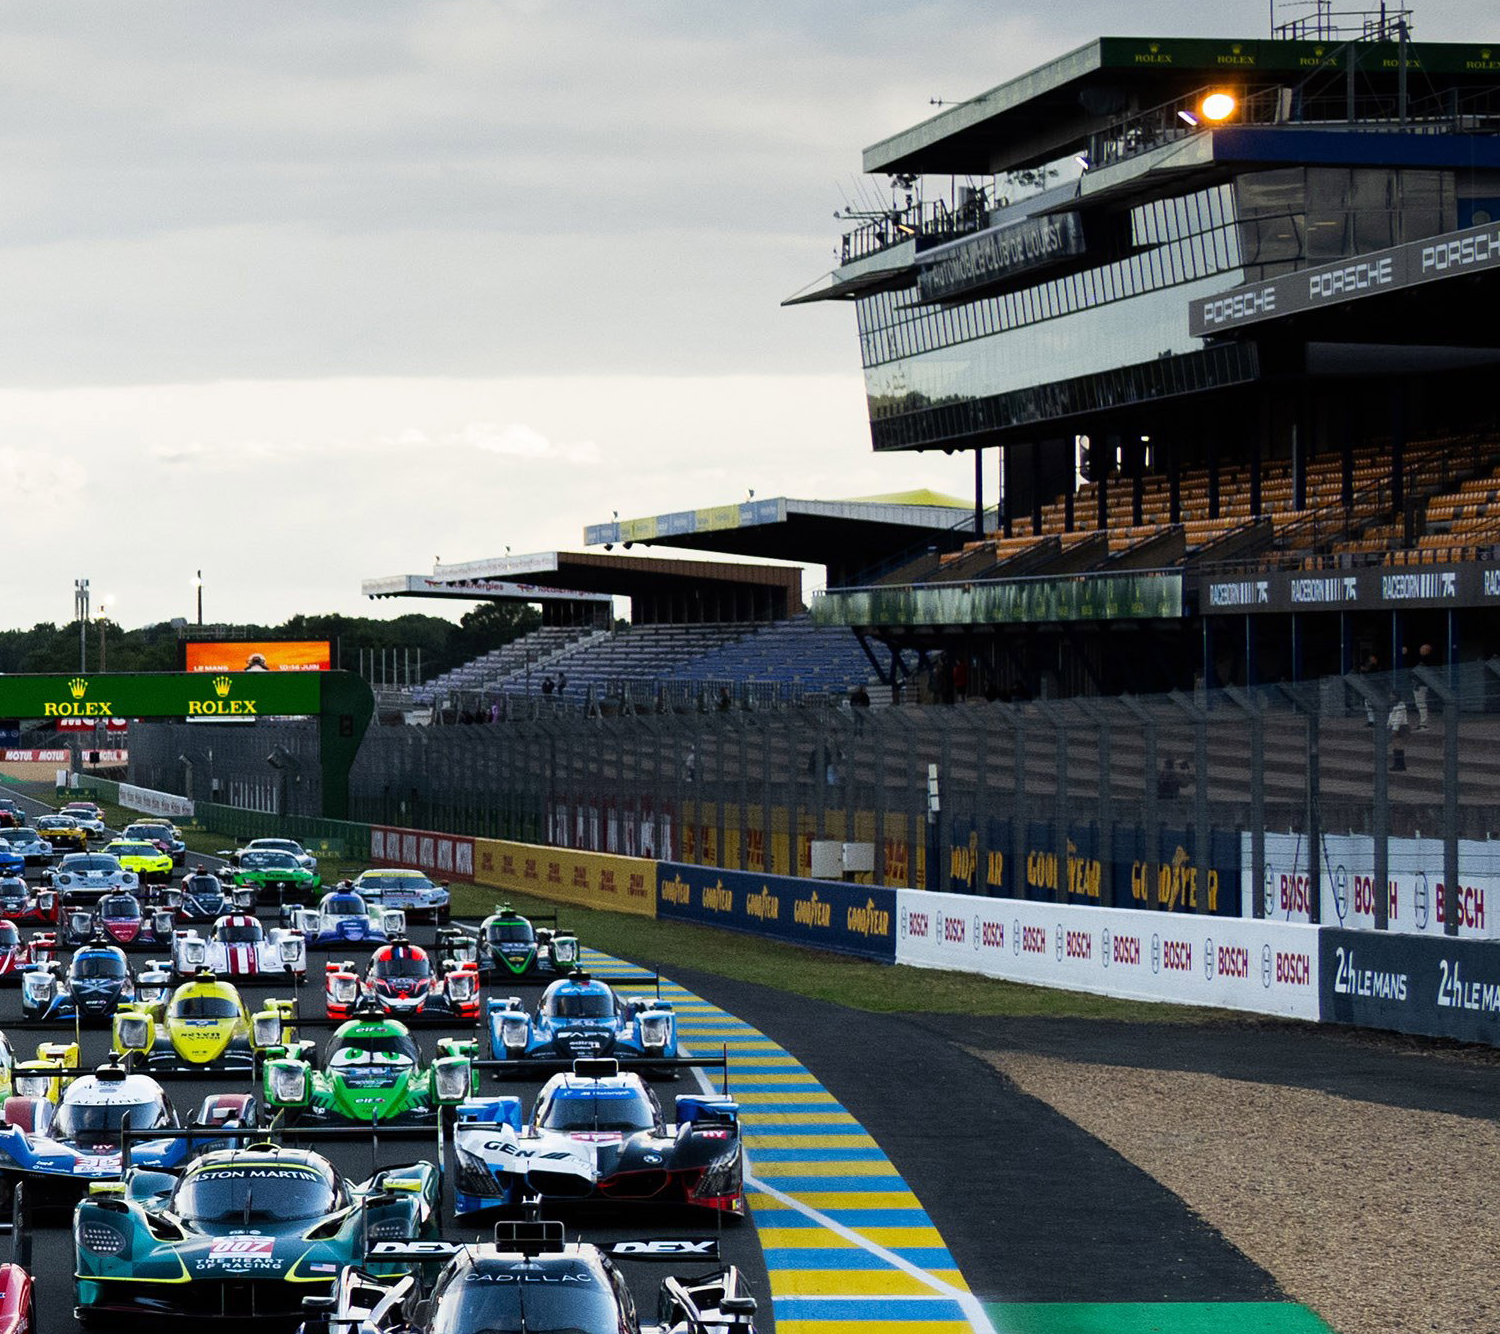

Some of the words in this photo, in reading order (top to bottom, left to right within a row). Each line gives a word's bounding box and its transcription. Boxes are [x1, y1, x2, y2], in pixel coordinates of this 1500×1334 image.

[1217, 55, 1255, 64] ROLEX
[1310, 258, 1392, 300] PORSCHE
[1204, 287, 1275, 325] PORSCHE
[44, 702, 112, 716] ROLEX
[188, 700, 257, 714] ROLEX
[909, 913, 928, 937] BOSCH
[945, 918, 965, 943] BOSCH
[982, 922, 1004, 948] BOSCH
[1023, 926, 1046, 953] BOSCH
[1067, 931, 1091, 959] BOSCH
[1114, 936, 1140, 965] BOSCH
[1164, 940, 1192, 971] BOSCH
[1218, 946, 1248, 978] BOSCH
[1276, 952, 1310, 985] BOSCH
[1334, 947, 1356, 994] 24h
[1357, 971, 1371, 996] LE
[1373, 973, 1407, 1001] MANS
[702, 1130, 726, 1139] HY
[484, 1140, 536, 1158] GEN
[193, 1168, 245, 1182] ASTON
[250, 1167, 319, 1183] MARTIN
[212, 1241, 271, 1252] 007
[612, 1241, 716, 1254] DEX
[465, 1273, 592, 1282] CADILLAC
